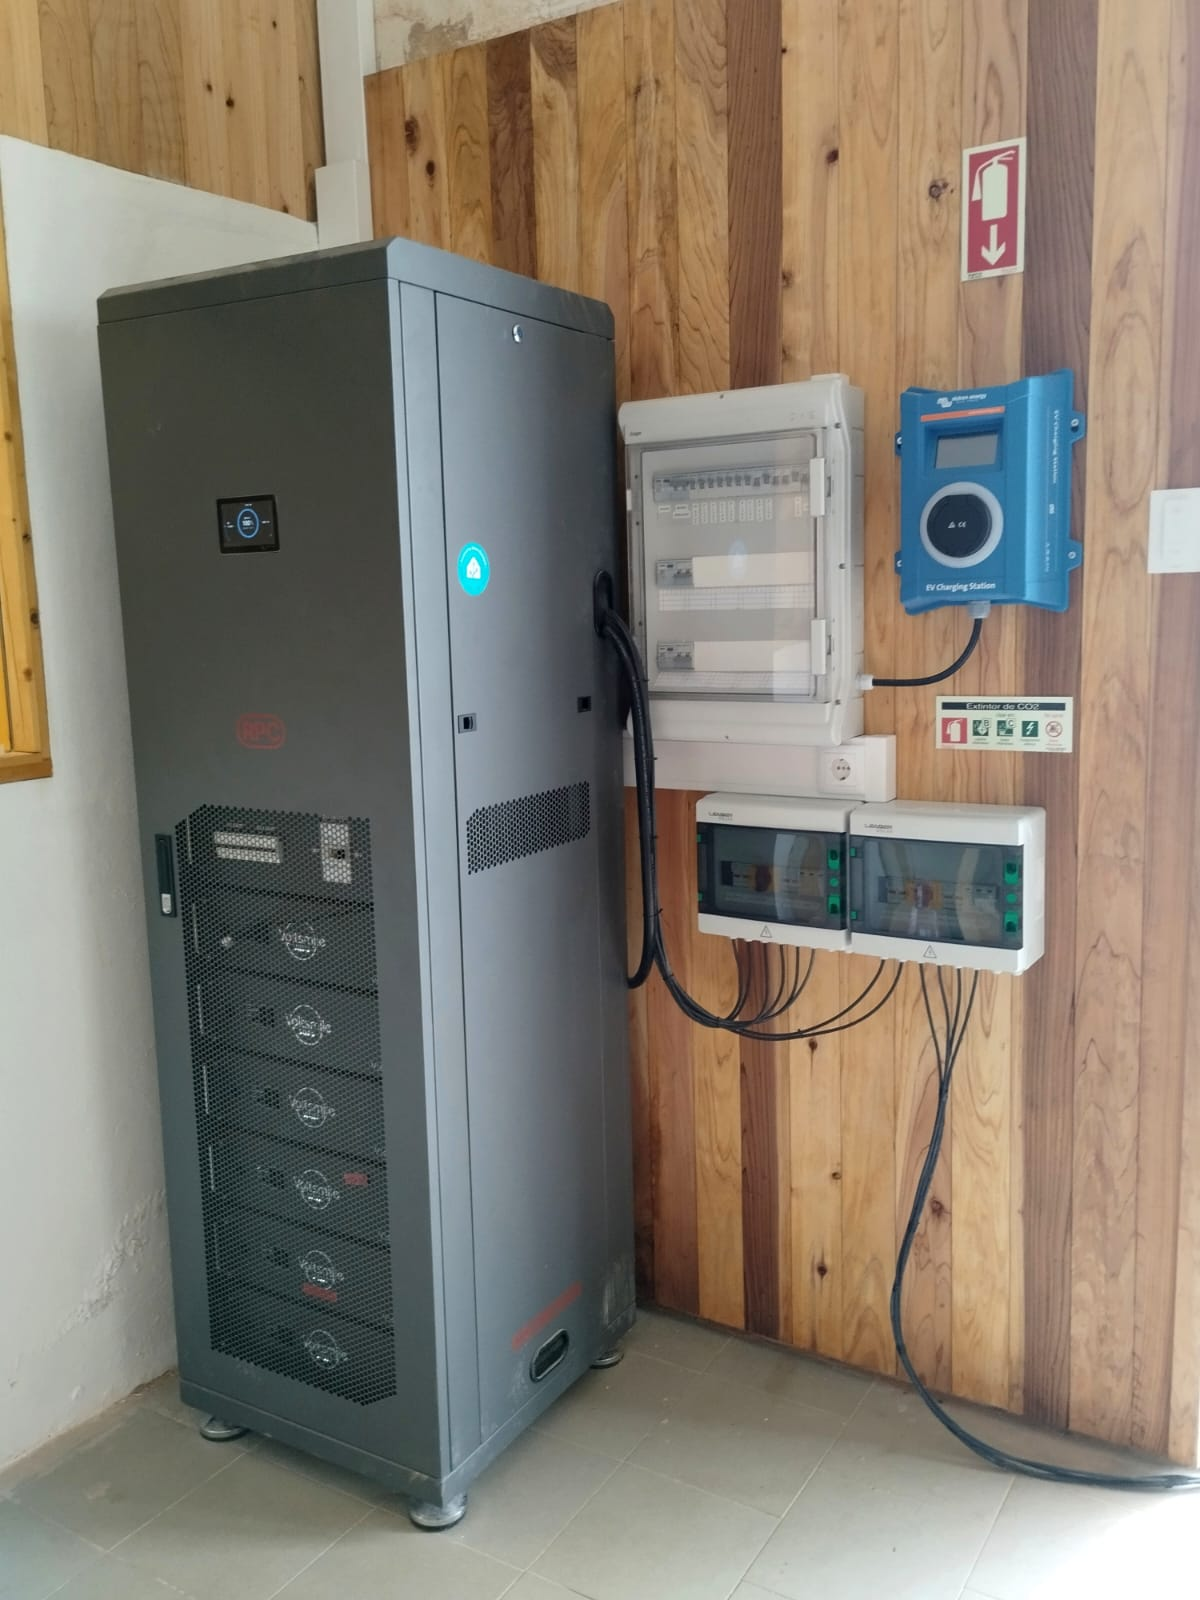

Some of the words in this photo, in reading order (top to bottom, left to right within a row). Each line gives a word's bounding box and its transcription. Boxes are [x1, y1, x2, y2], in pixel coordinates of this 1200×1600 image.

[926, 583, 936, 591] EV
[936, 582, 969, 593] Charging
[969, 581, 996, 590] Station
[965, 702, 1001, 710] Extintor
[1017, 703, 1040, 711] CO2
